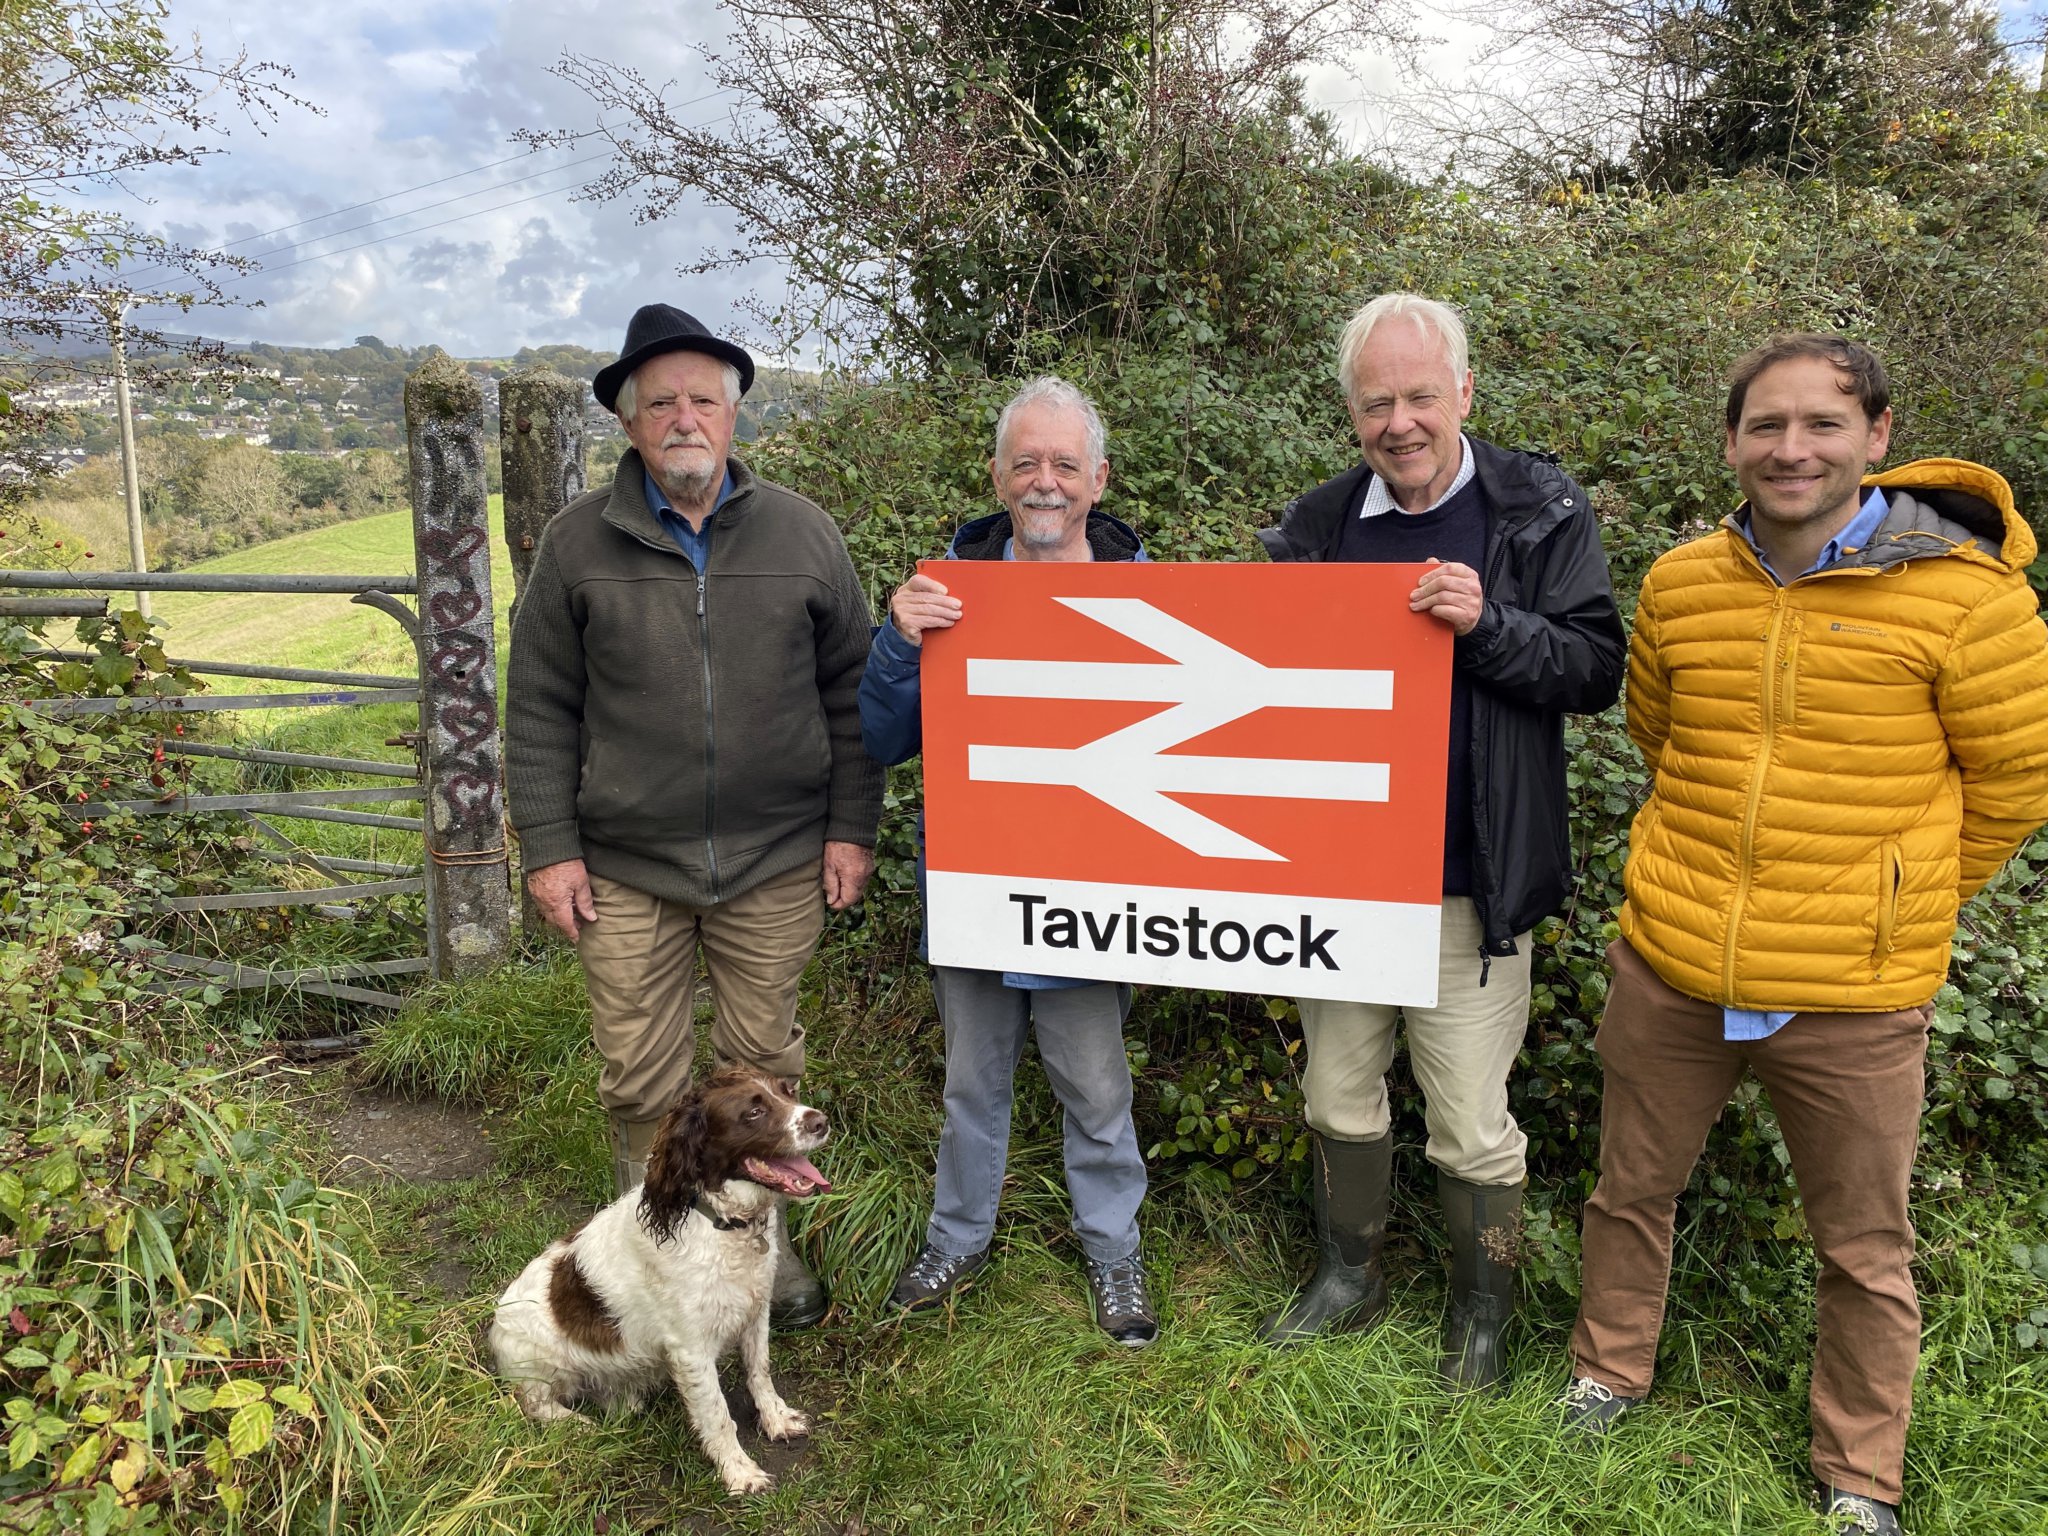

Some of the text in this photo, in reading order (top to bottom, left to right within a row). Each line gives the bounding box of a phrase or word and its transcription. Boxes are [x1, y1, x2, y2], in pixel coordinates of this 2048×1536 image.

[1841, 623, 1881, 632] MOUNTAIN
[1840, 628, 1888, 638] WAREHOUSE
[1008, 893, 1341, 971] Tavistock
